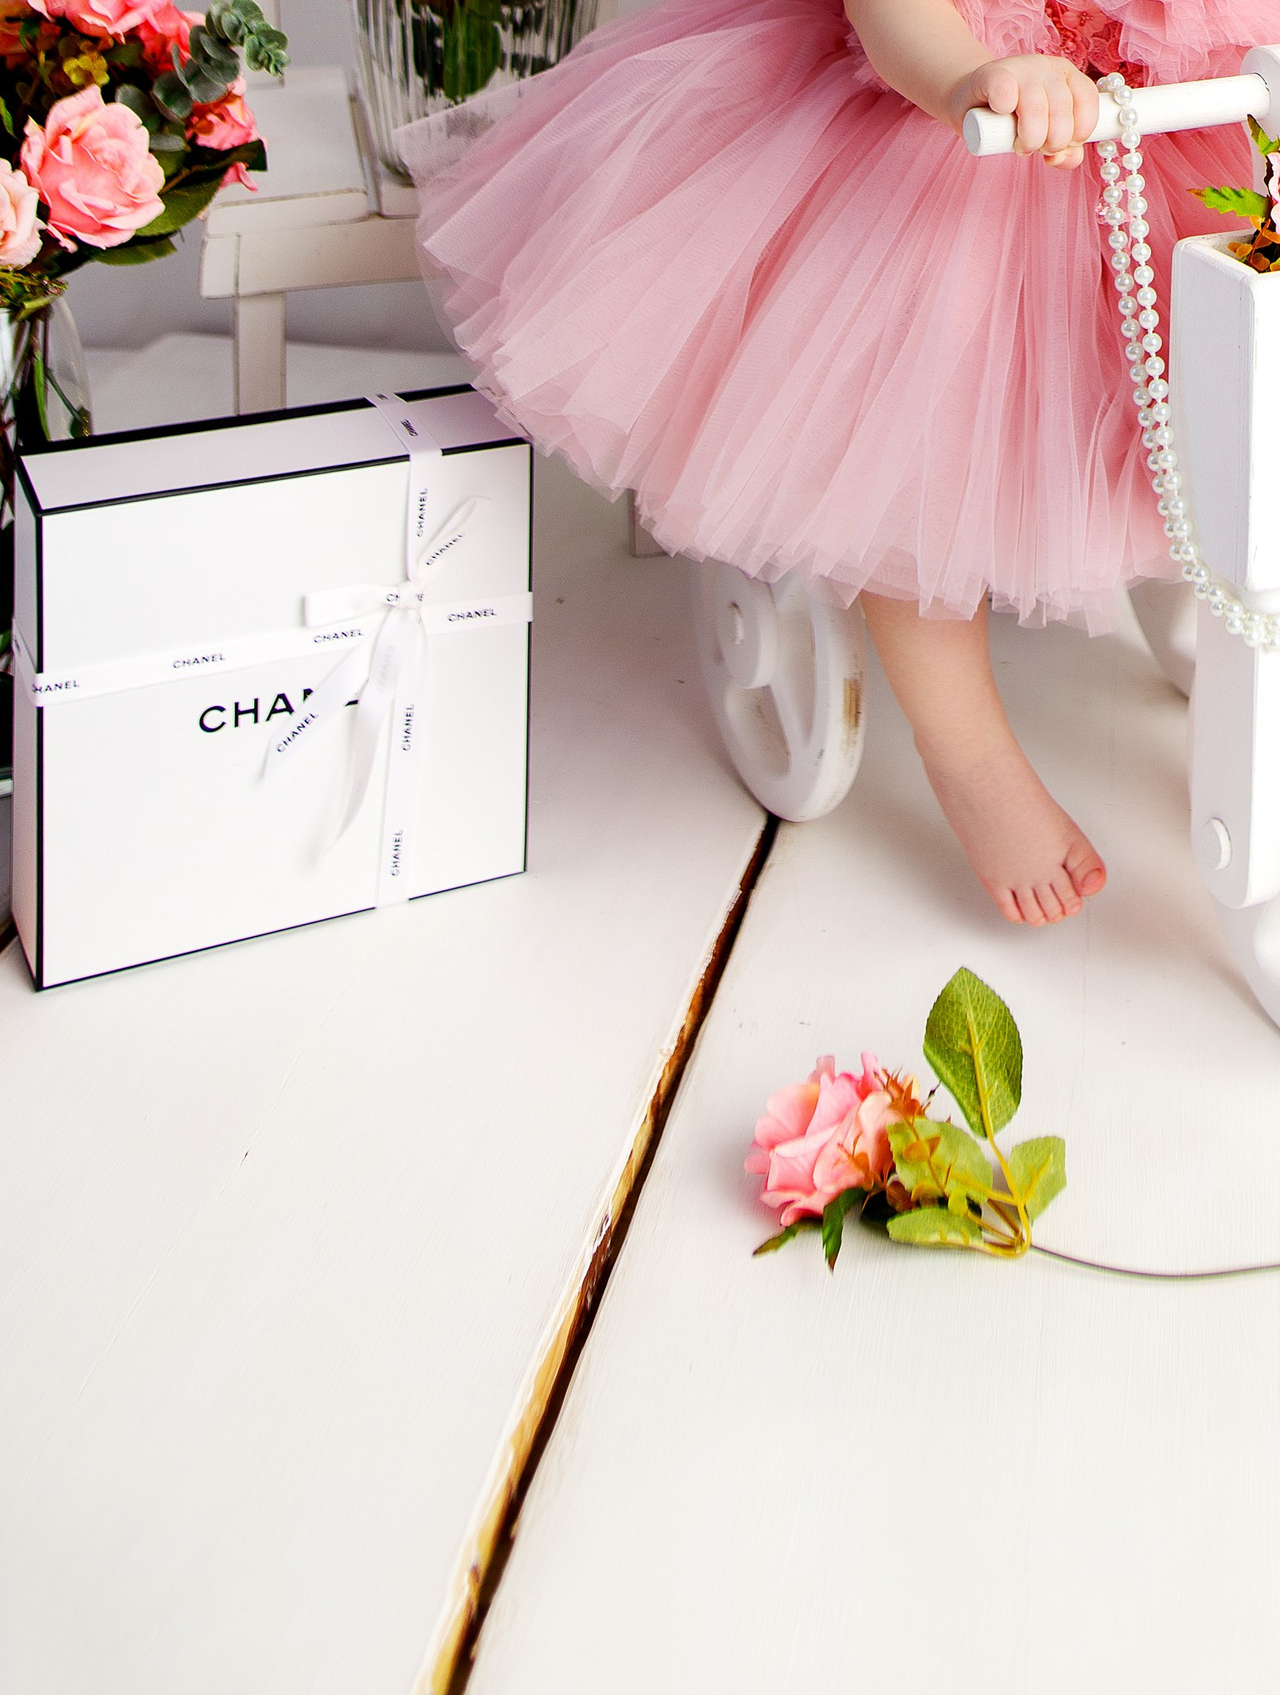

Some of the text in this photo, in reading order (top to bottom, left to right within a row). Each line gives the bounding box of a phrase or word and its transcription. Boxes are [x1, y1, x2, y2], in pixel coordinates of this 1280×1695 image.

[417, 488, 428, 537] CHANEL
[425, 533, 464, 566] CHANEL
[447, 608, 497, 622] CHANEL
[313, 629, 364, 643] CHANEL
[172, 653, 226, 669] CHANEL
[276, 712, 318, 753] CHANEL
[402, 704, 414, 752] CHANEL
[391, 830, 403, 877] CHANEL
